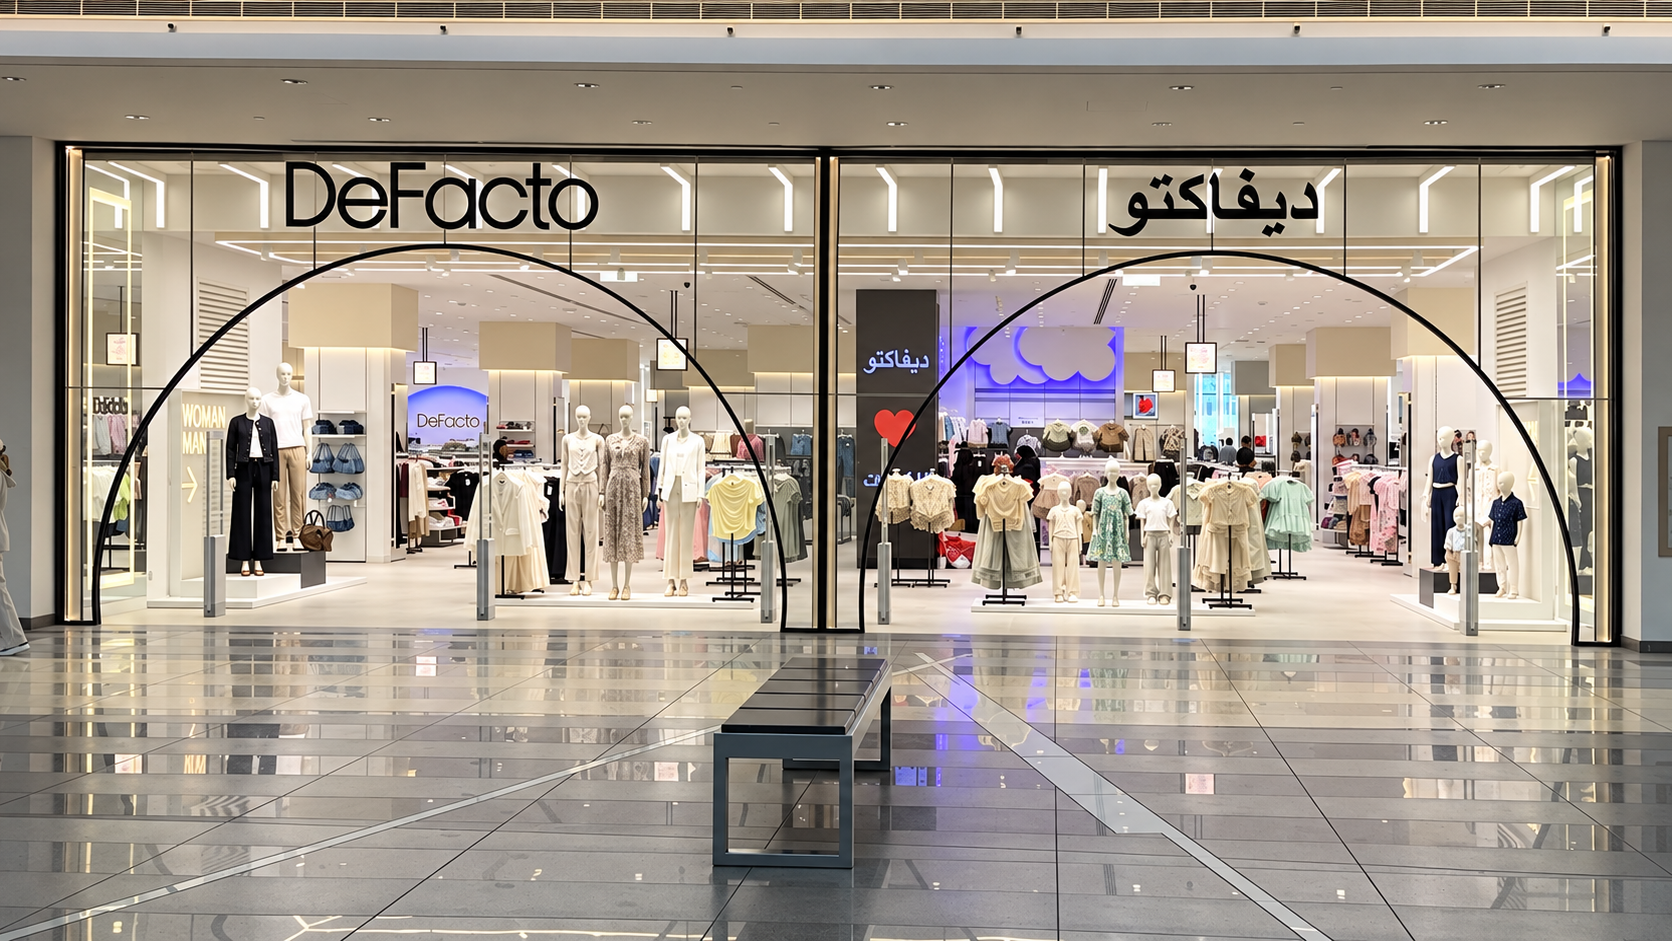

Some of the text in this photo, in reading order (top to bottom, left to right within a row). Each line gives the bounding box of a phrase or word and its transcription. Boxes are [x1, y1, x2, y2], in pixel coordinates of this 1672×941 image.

[285, 161, 599, 230] DeFacto
[1108, 167, 1319, 237] ديفاكتو
[863, 348, 930, 374] ديفاكتو
[182, 403, 226, 429] WOMAN
[417, 413, 480, 428] DeFacto
[182, 431, 207, 455] MAN
